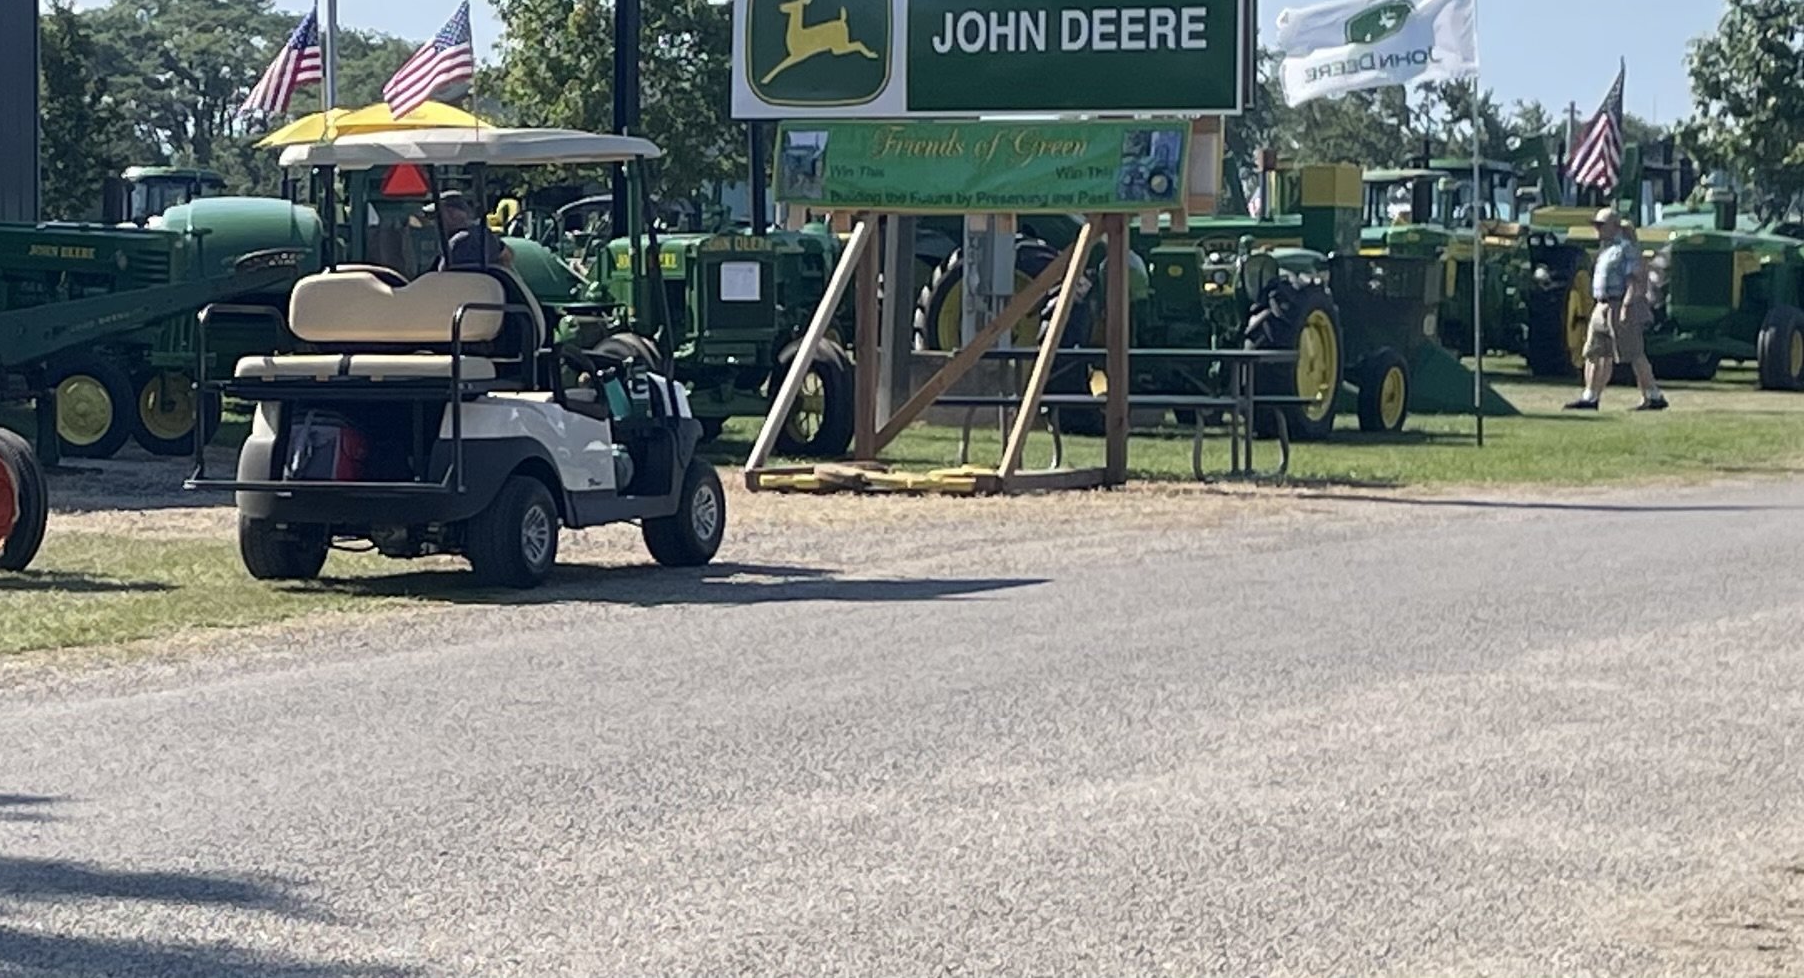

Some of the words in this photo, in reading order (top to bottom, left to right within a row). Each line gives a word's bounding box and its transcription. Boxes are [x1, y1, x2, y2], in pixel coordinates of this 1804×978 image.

[931, 11, 1046, 54] JOHN
[1060, 7, 1208, 51] DEERE
[870, 125, 966, 161] Friends
[974, 128, 1007, 168] of
[1011, 127, 1089, 167] Green
